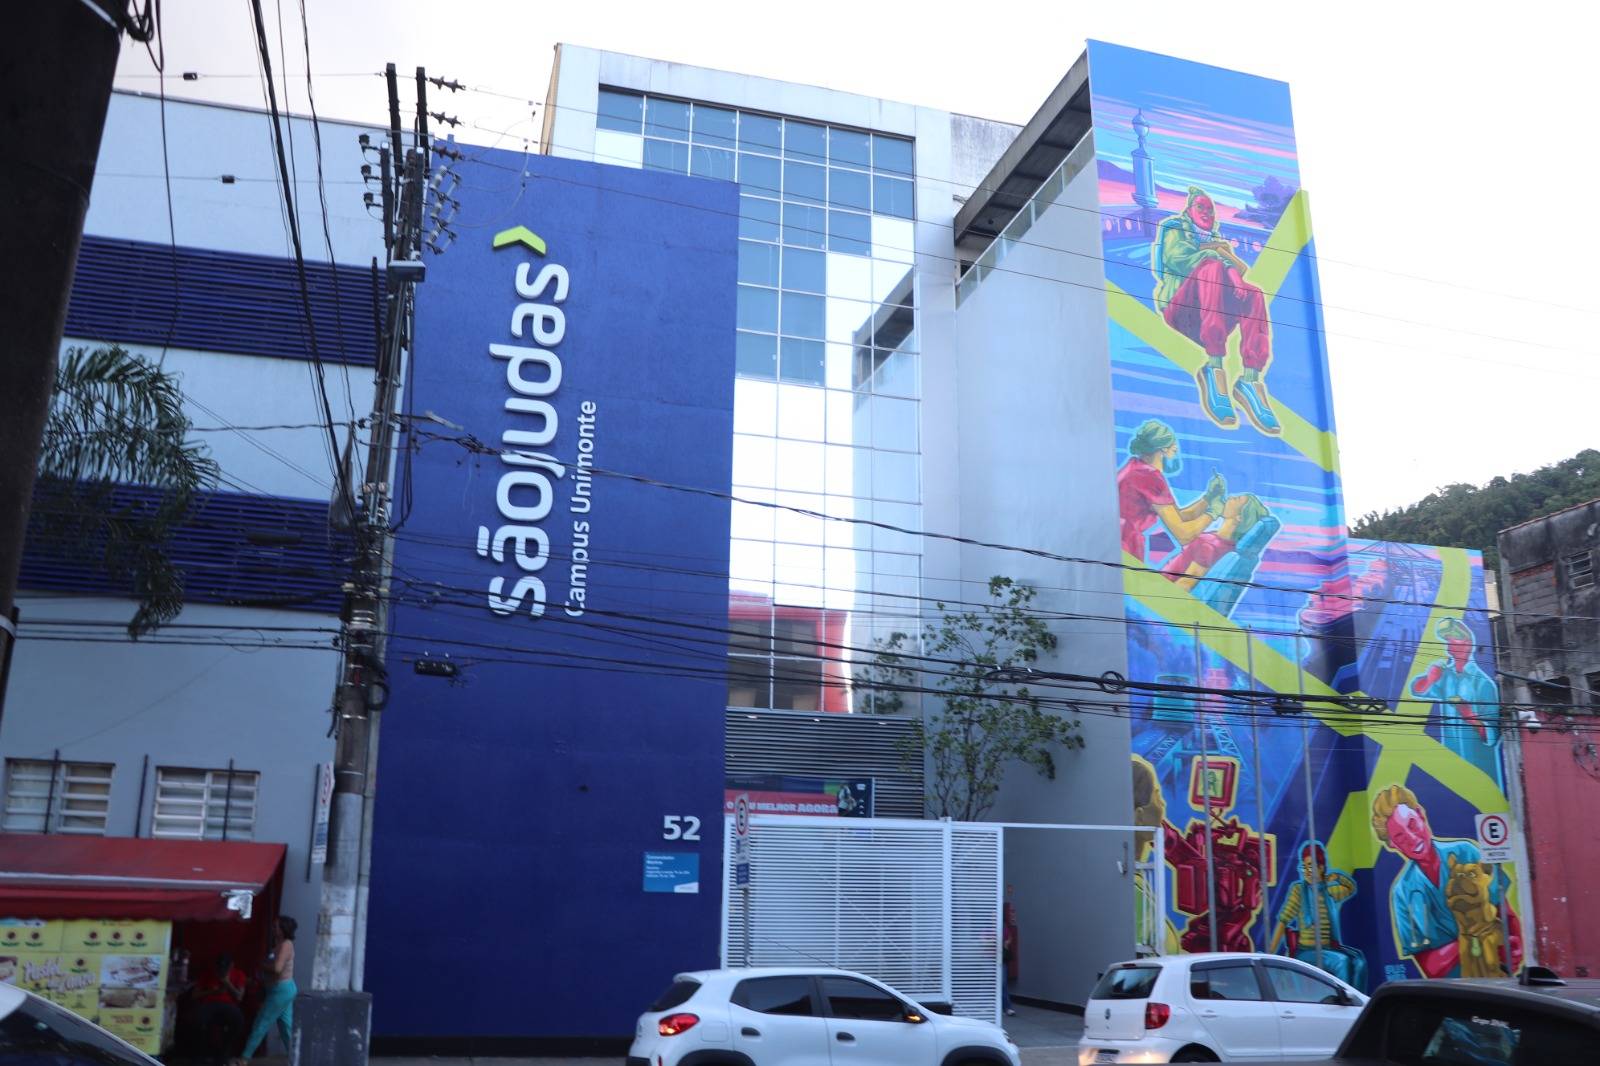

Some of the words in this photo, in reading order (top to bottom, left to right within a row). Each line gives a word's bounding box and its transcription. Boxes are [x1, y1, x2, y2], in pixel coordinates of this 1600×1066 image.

[571, 400, 597, 514] Unimonte
[565, 520, 590, 618] Campus
[663, 814, 701, 841] 52
[1488, 822, 1500, 839] E
